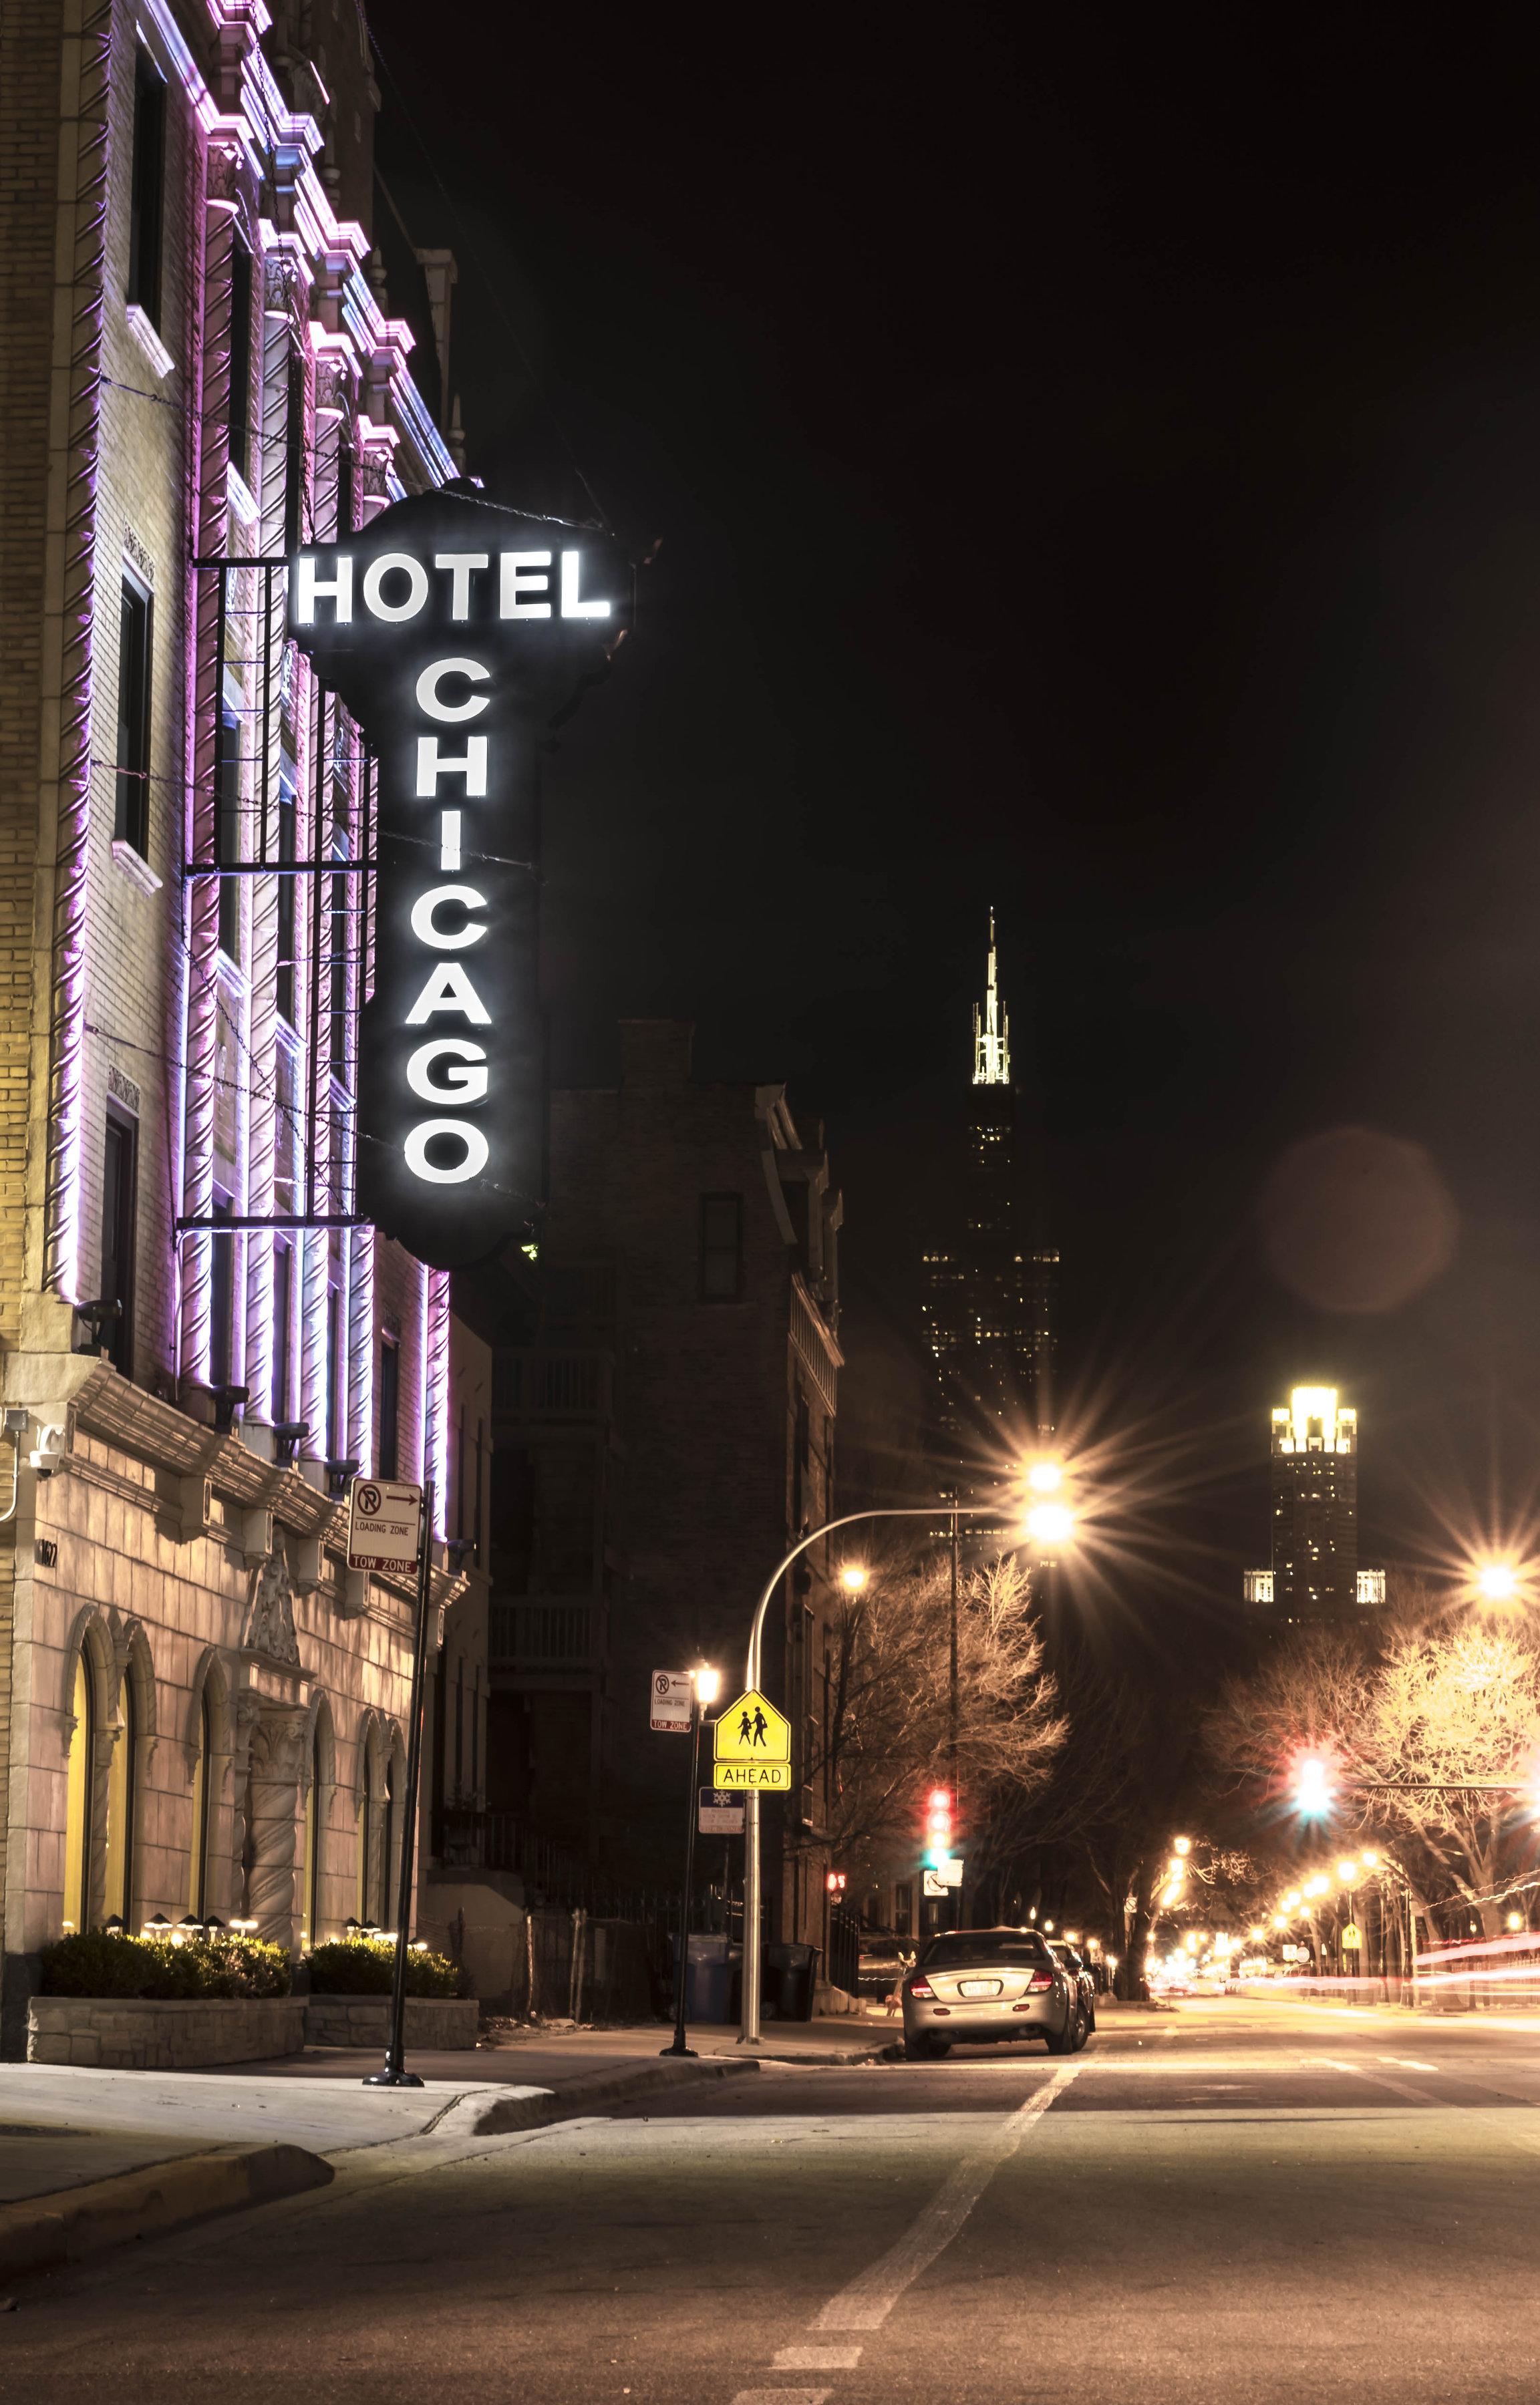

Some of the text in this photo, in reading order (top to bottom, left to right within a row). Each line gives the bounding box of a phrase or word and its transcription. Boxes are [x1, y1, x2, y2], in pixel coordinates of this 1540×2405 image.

[298, 551, 611, 624] HOTEL
[404, 657, 492, 1184] CHICAGO
[355, 1521, 409, 1536] LOADING ZONE
[353, 1555, 412, 1573] TOW ZONE
[654, 1720, 687, 1730] TOW ZONE
[723, 1768, 782, 1784] AHEAD
